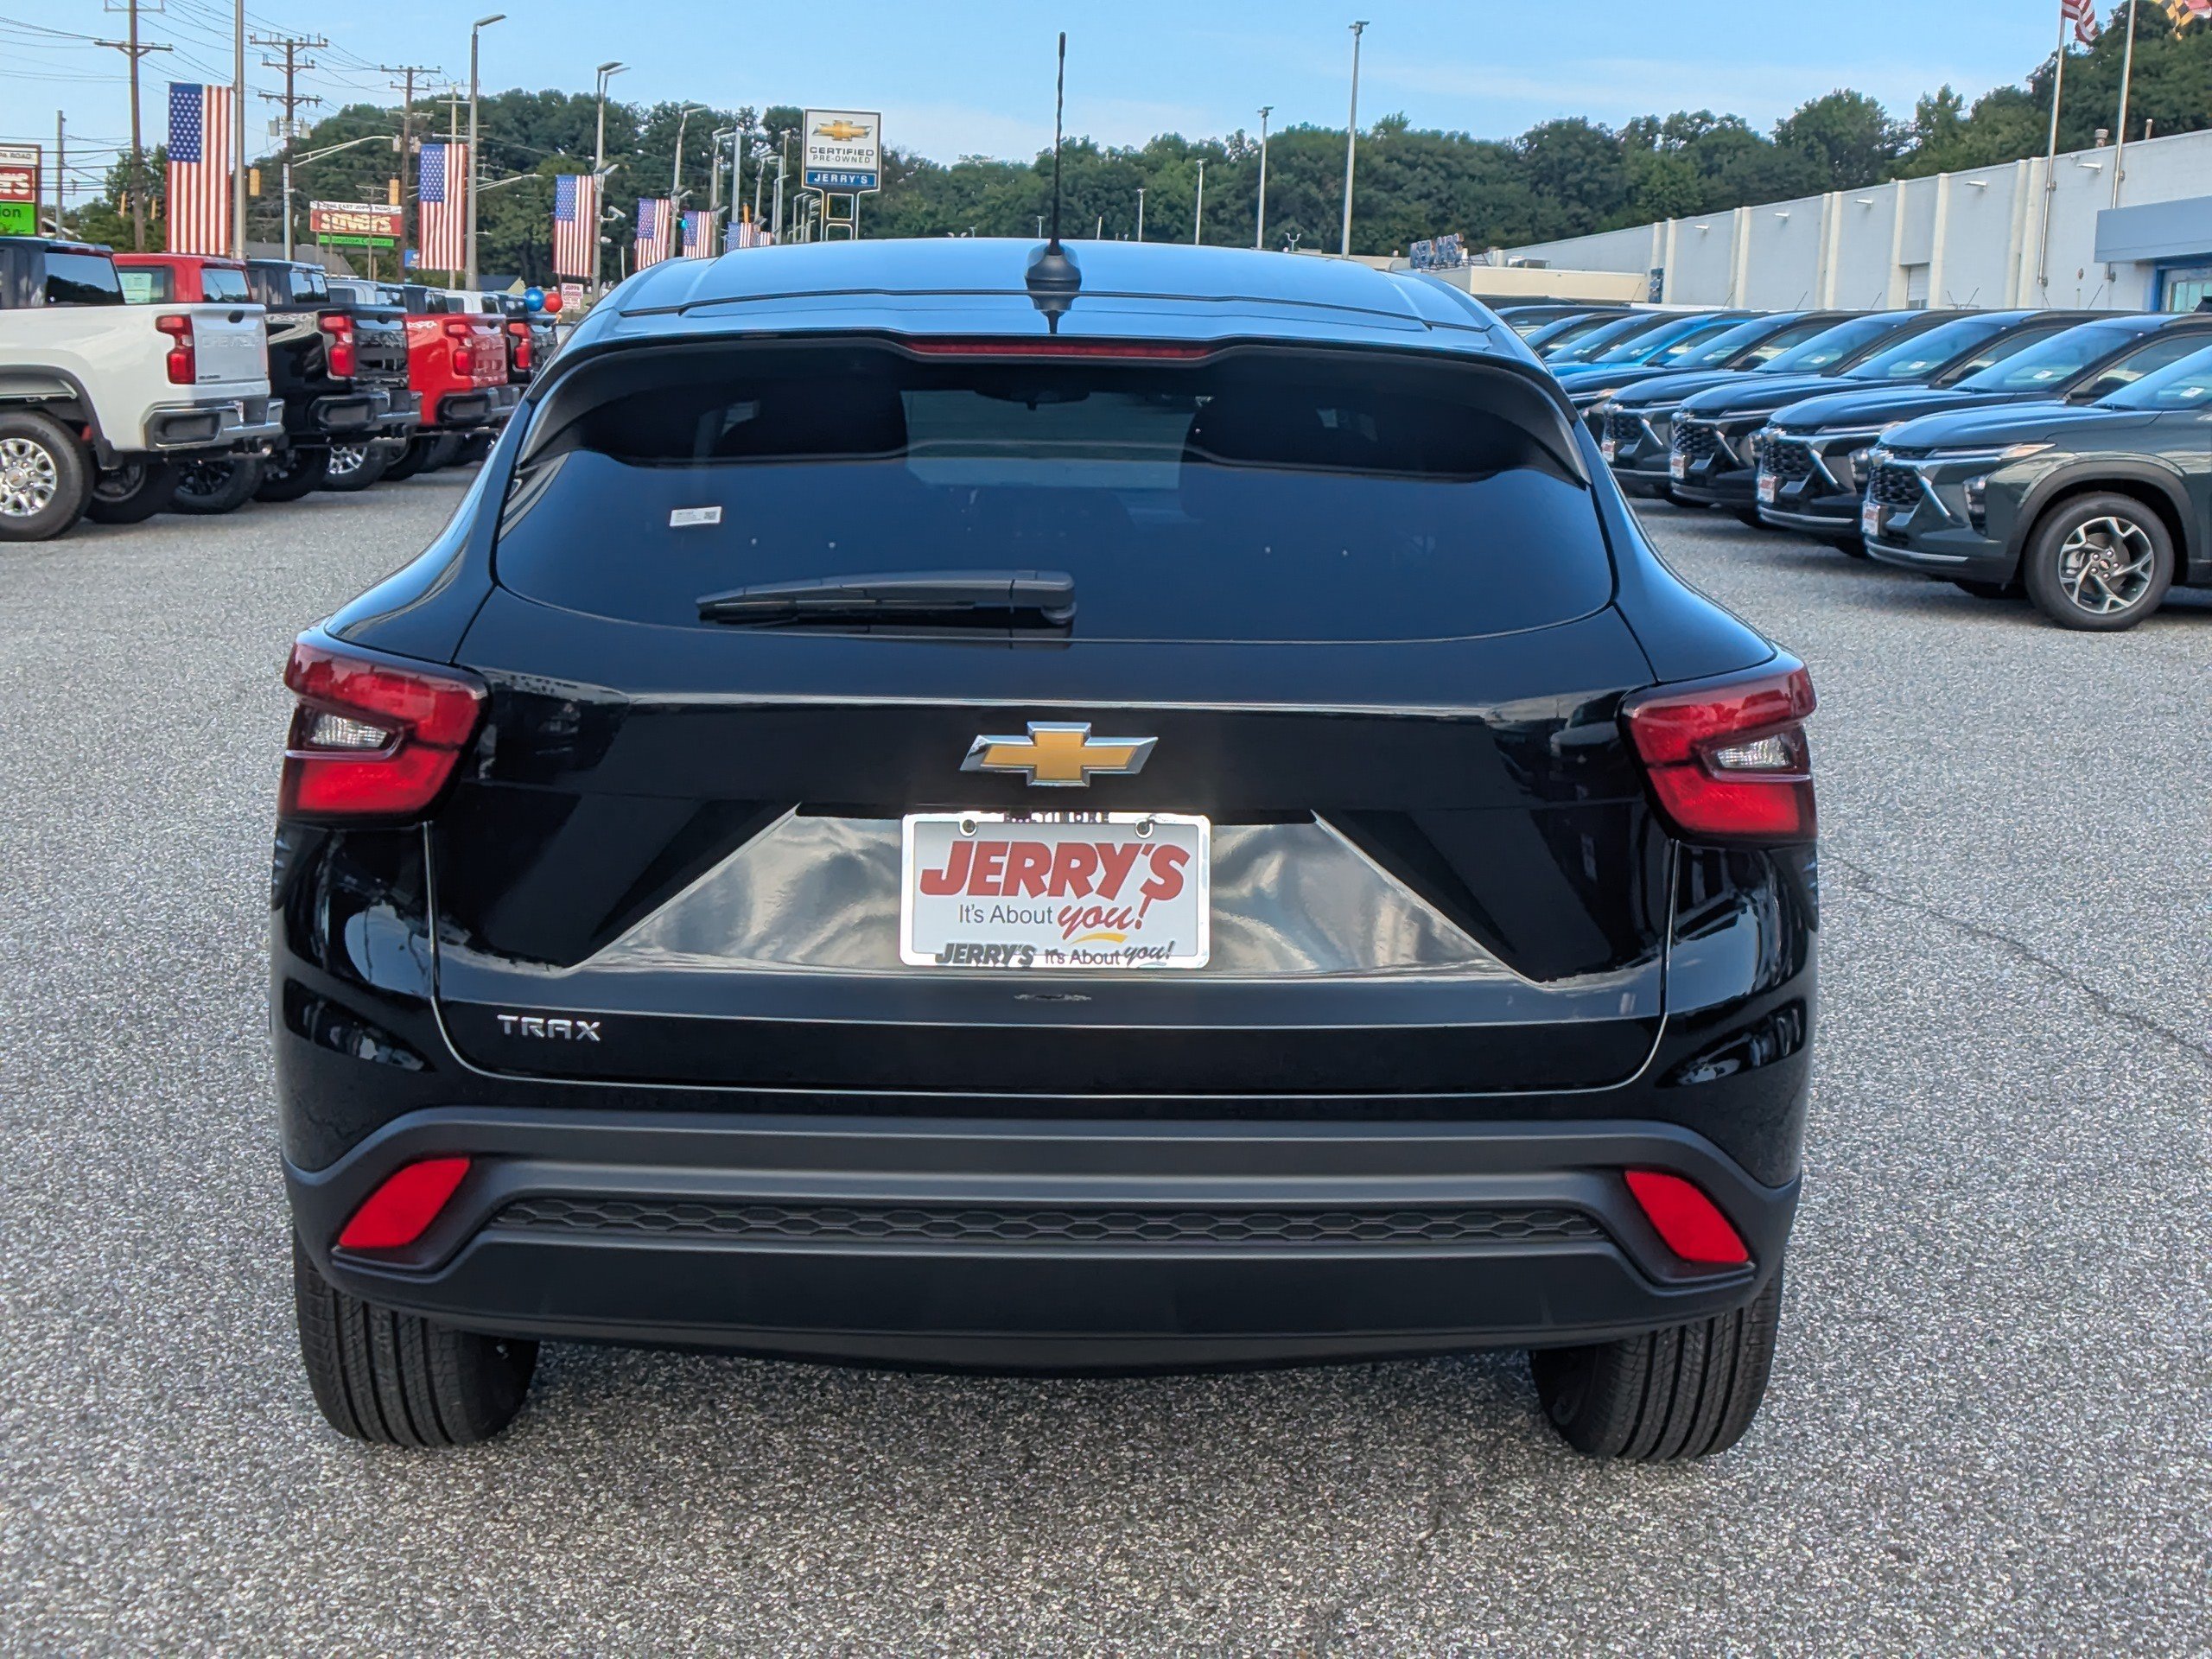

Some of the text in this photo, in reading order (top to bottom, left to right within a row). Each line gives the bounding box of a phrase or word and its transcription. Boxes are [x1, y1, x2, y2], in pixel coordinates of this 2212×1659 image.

[809, 146, 874, 156] CERTIFIED
[812, 155, 871, 163] PRE-OWNED
[814, 173, 868, 184] JERRY'S
[919, 841, 1191, 901] JERRY'S
[959, 895, 1154, 940] It's About you!
[935, 943, 1038, 967] JERRY'S
[1070, 949, 1121, 965] About
[1123, 940, 1175, 966] you!
[497, 1014, 601, 1041] TRAX
